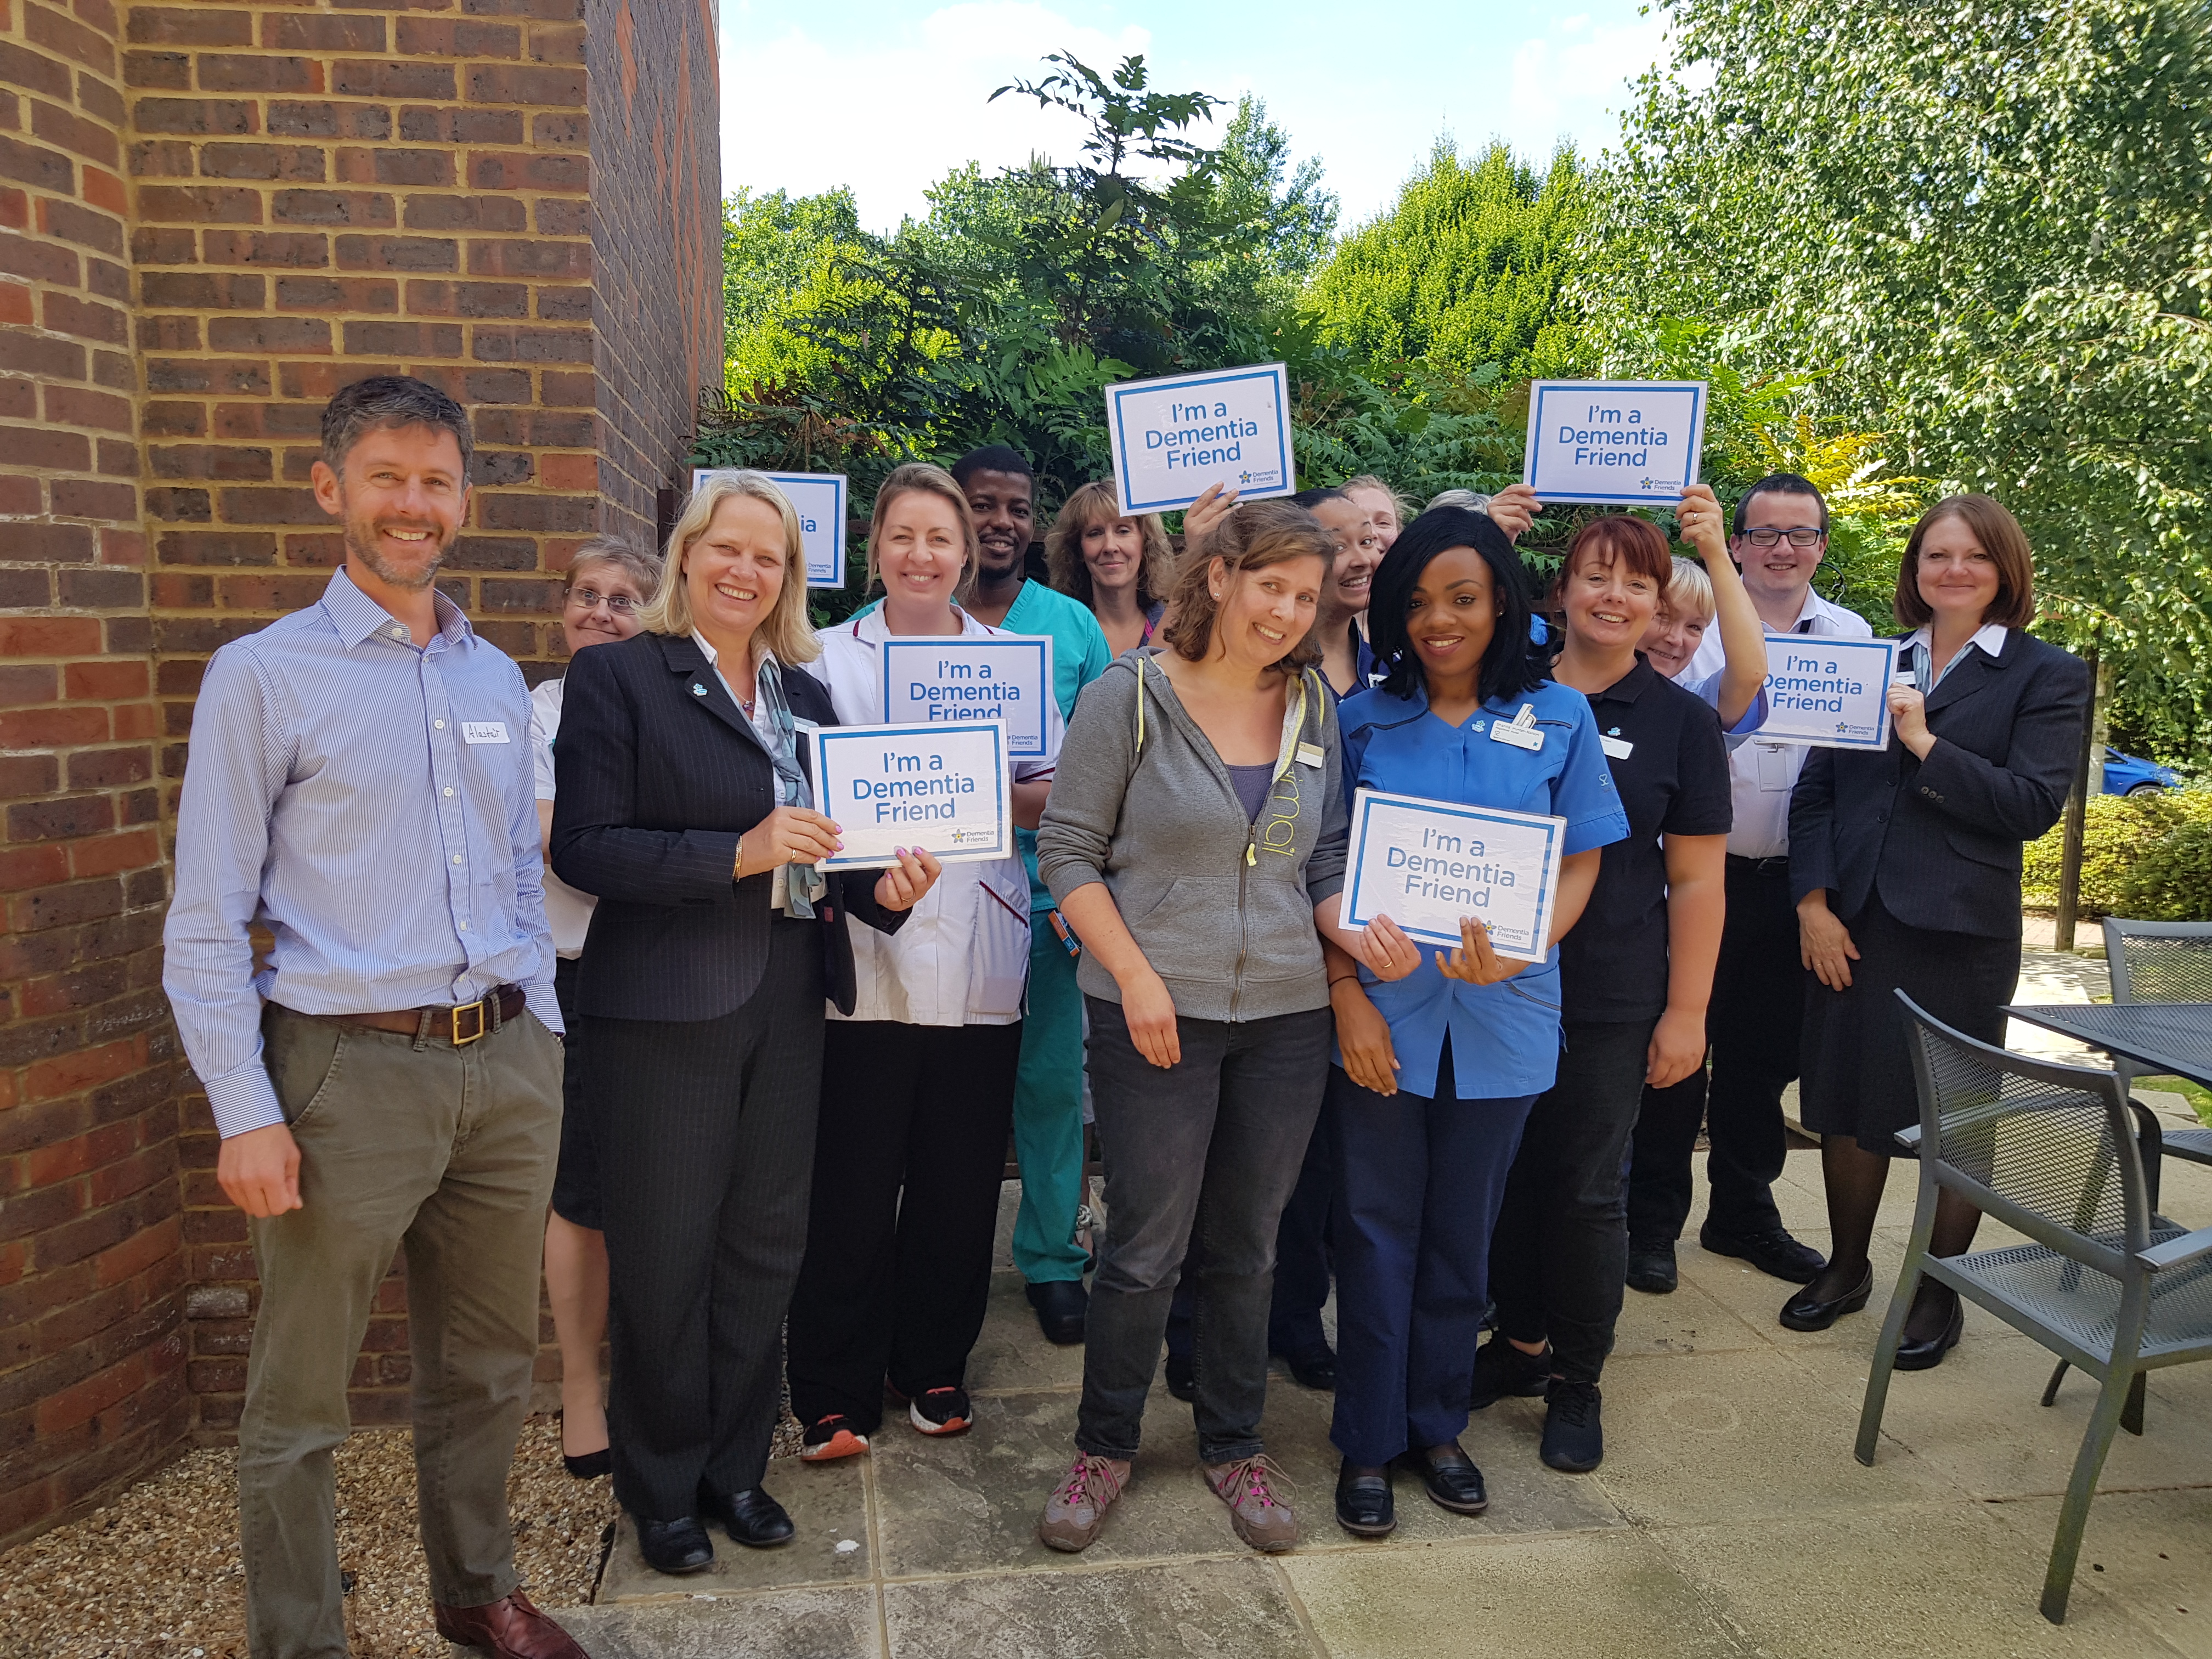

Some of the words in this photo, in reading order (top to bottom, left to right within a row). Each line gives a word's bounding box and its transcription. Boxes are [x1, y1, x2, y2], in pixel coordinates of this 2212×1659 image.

[1172, 403, 1206, 423] I'm
[1214, 402, 1227, 417] a
[1588, 405, 1621, 424] I'm
[1628, 409, 1641, 424] a
[1146, 417, 1258, 449] Dementia
[1559, 426, 1668, 445] Dementia
[1166, 441, 1241, 470] Friend
[1575, 447, 1647, 467] Friend
[1252, 469, 1279, 477] Dementia
[938, 661, 972, 679] I'm
[979, 663, 992, 679] a
[1787, 655, 1818, 673] I'm
[1825, 661, 1837, 674] a
[910, 681, 1020, 701] Dementia
[1763, 673, 1863, 695] Dementia
[929, 703, 1002, 720] Friend
[1773, 692, 1843, 713] Friend
[883, 752, 921, 774] I'm
[929, 754, 943, 771] a
[853, 772, 974, 800] Dementia
[876, 798, 956, 823] Friend
[1422, 827, 1462, 854] I'm
[1469, 839, 1485, 857] a
[1387, 846, 1515, 888] Dementia
[1404, 874, 1491, 908] Friend
[1497, 925, 1530, 936] Dementia
[1497, 931, 1522, 941] Friends
